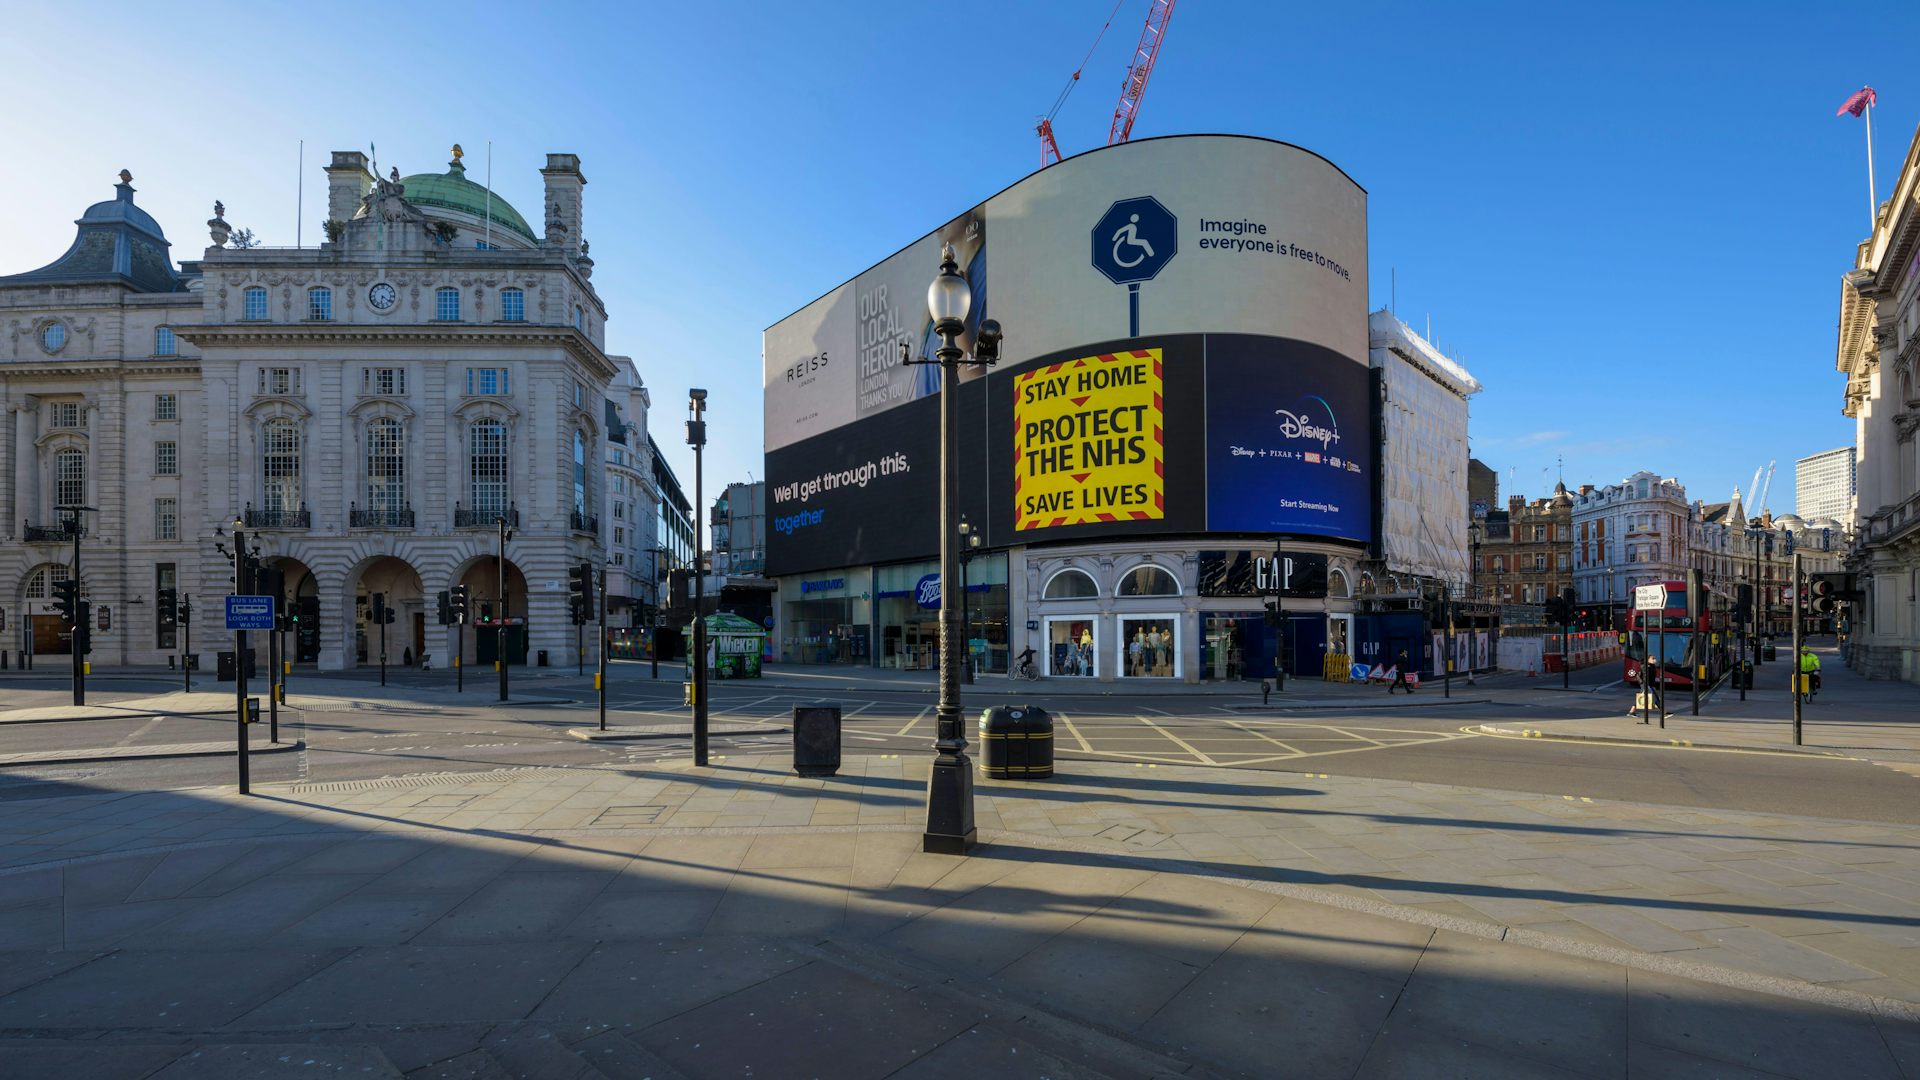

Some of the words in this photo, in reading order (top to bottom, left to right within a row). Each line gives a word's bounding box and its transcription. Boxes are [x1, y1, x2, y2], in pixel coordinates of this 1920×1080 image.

[1200, 218, 1267, 235] Imagine
[1199, 237, 1274, 253] everyone
[1276, 240, 1287, 255] is
[1289, 243, 1314, 262] free
[1314, 251, 1326, 266] to
[1326, 258, 1351, 282] move.
[860, 283, 888, 321] OUR
[860, 305, 904, 350] LOCAL
[787, 351, 828, 383] REISS
[860, 330, 915, 378] HEROES
[860, 370, 889, 395] LONDON
[860, 387, 888, 411] THANKS
[888, 382, 903, 401] YOU
[1025, 375, 1070, 404] STAY
[1077, 364, 1147, 393] HOME
[1025, 404, 1148, 449] PROTECT
[1026, 444, 1074, 477] THE
[1082, 436, 1146, 469] NHS
[1229, 445, 1255, 458] Disney
[1270, 449, 1293, 458] PIXAR
[774, 482, 799, 504] We'll
[800, 475, 823, 502] get
[823, 461, 877, 492] through
[879, 451, 911, 478] this,
[1025, 490, 1074, 515] SAVE
[1083, 483, 1148, 508] LIVES
[1280, 498, 1297, 508] Start
[1298, 500, 1328, 513] Streaming
[1328, 503, 1340, 513] Now
[774, 506, 825, 536] together
[1256, 556, 1293, 590] GAP
[917, 578, 941, 604] Boo
[1681, 618, 1692, 626] 19
[1362, 641, 1380, 655] GAP
